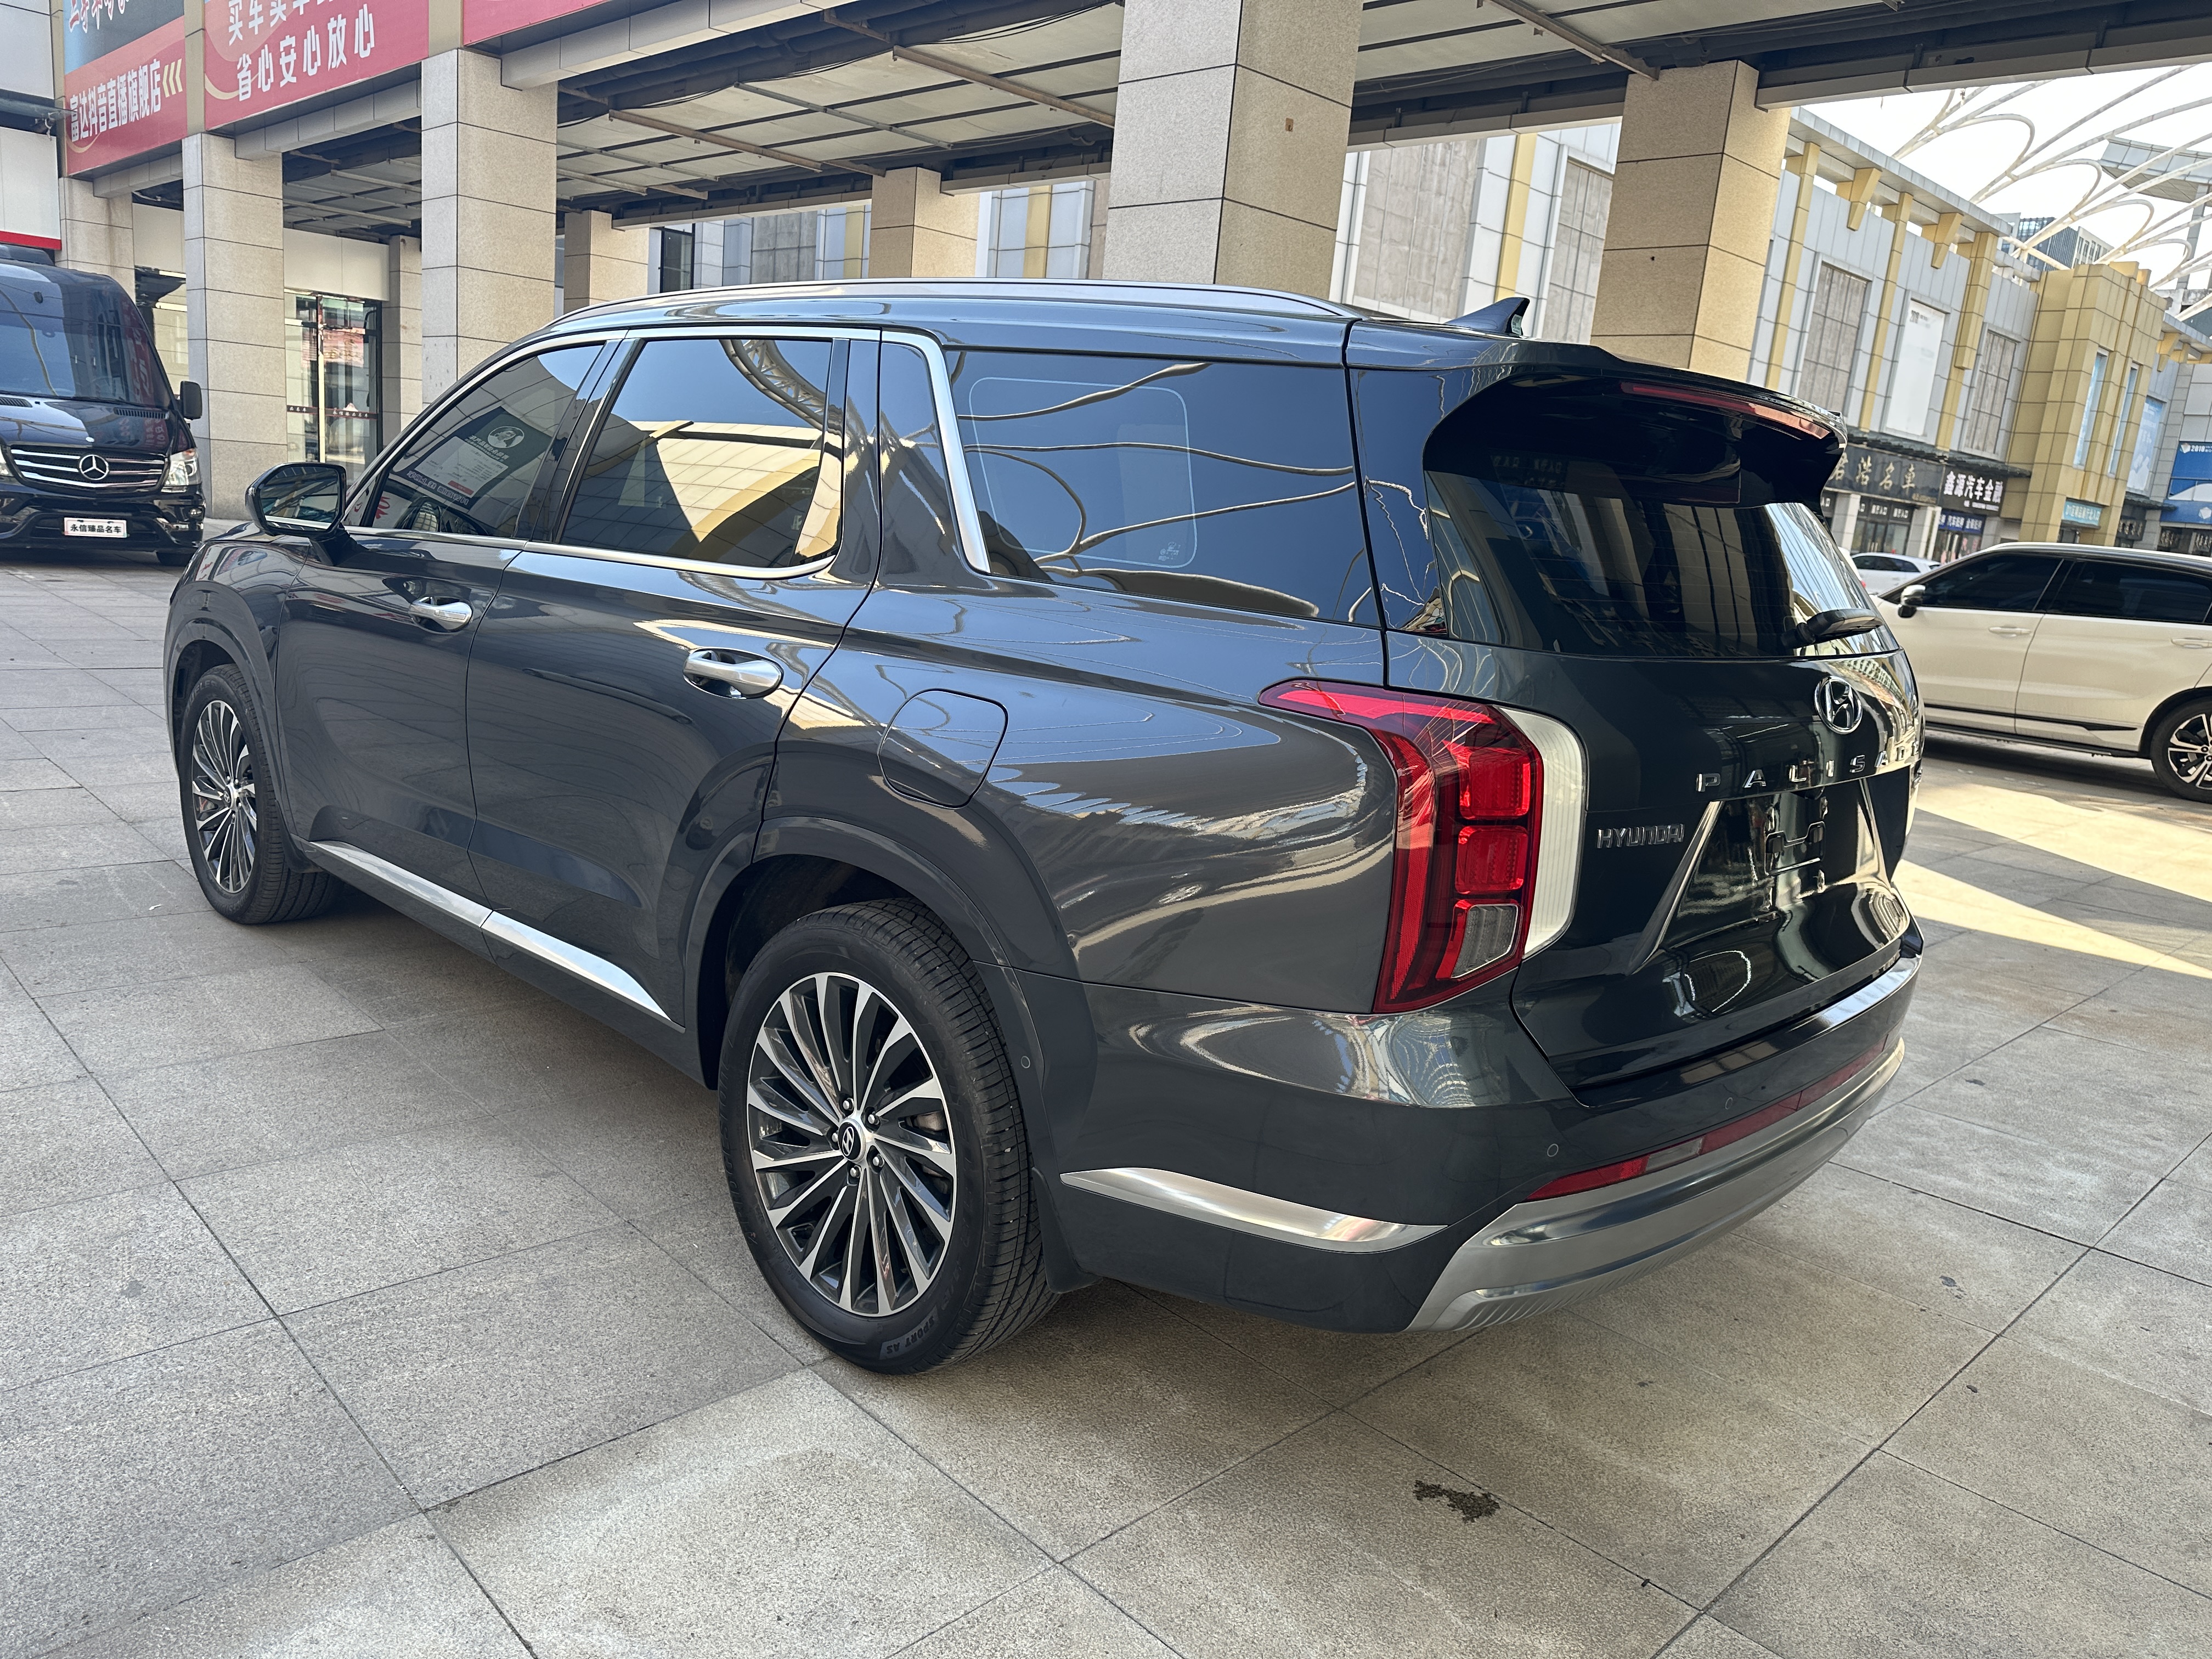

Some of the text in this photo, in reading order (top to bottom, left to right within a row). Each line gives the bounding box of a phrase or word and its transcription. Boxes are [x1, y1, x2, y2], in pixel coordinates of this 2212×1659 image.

[237, 3, 375, 101] 省心安心放心
[70, 59, 161, 143] 富达抖音直播旗舰店
[70, 524, 122, 533] 永信臻品名车
[1695, 741, 1919, 792] PALISADE
[1596, 823, 1685, 849] HYUNDAI
[905, 1316, 935, 1347] SPORT
[886, 1342, 900, 1355] AS
